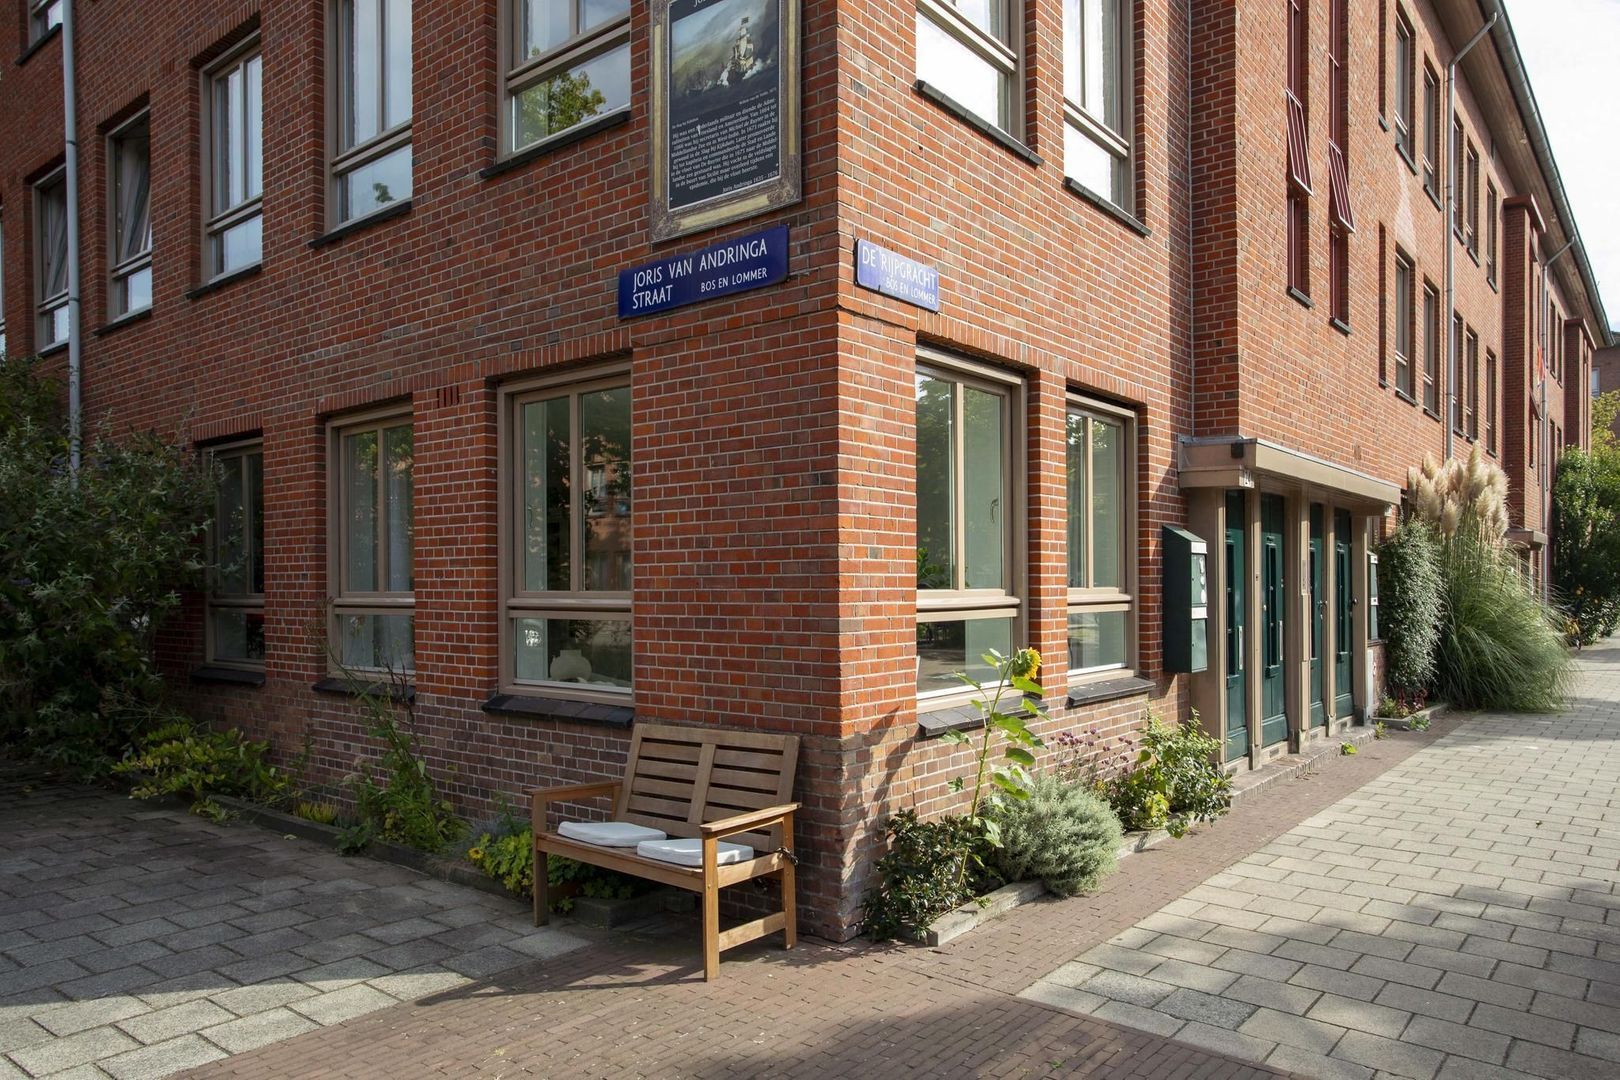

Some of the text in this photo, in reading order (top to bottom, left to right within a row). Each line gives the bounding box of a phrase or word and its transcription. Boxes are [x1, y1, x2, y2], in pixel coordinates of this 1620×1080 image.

[633, 238, 768, 292] JORIS VAN ANDRINGA
[862, 247, 936, 290] DE RIJPGRACHT
[700, 268, 768, 292] BOS EN LOMMER
[886, 278, 936, 305] BOS EN LOMMER
[632, 285, 673, 310] STRAAT
